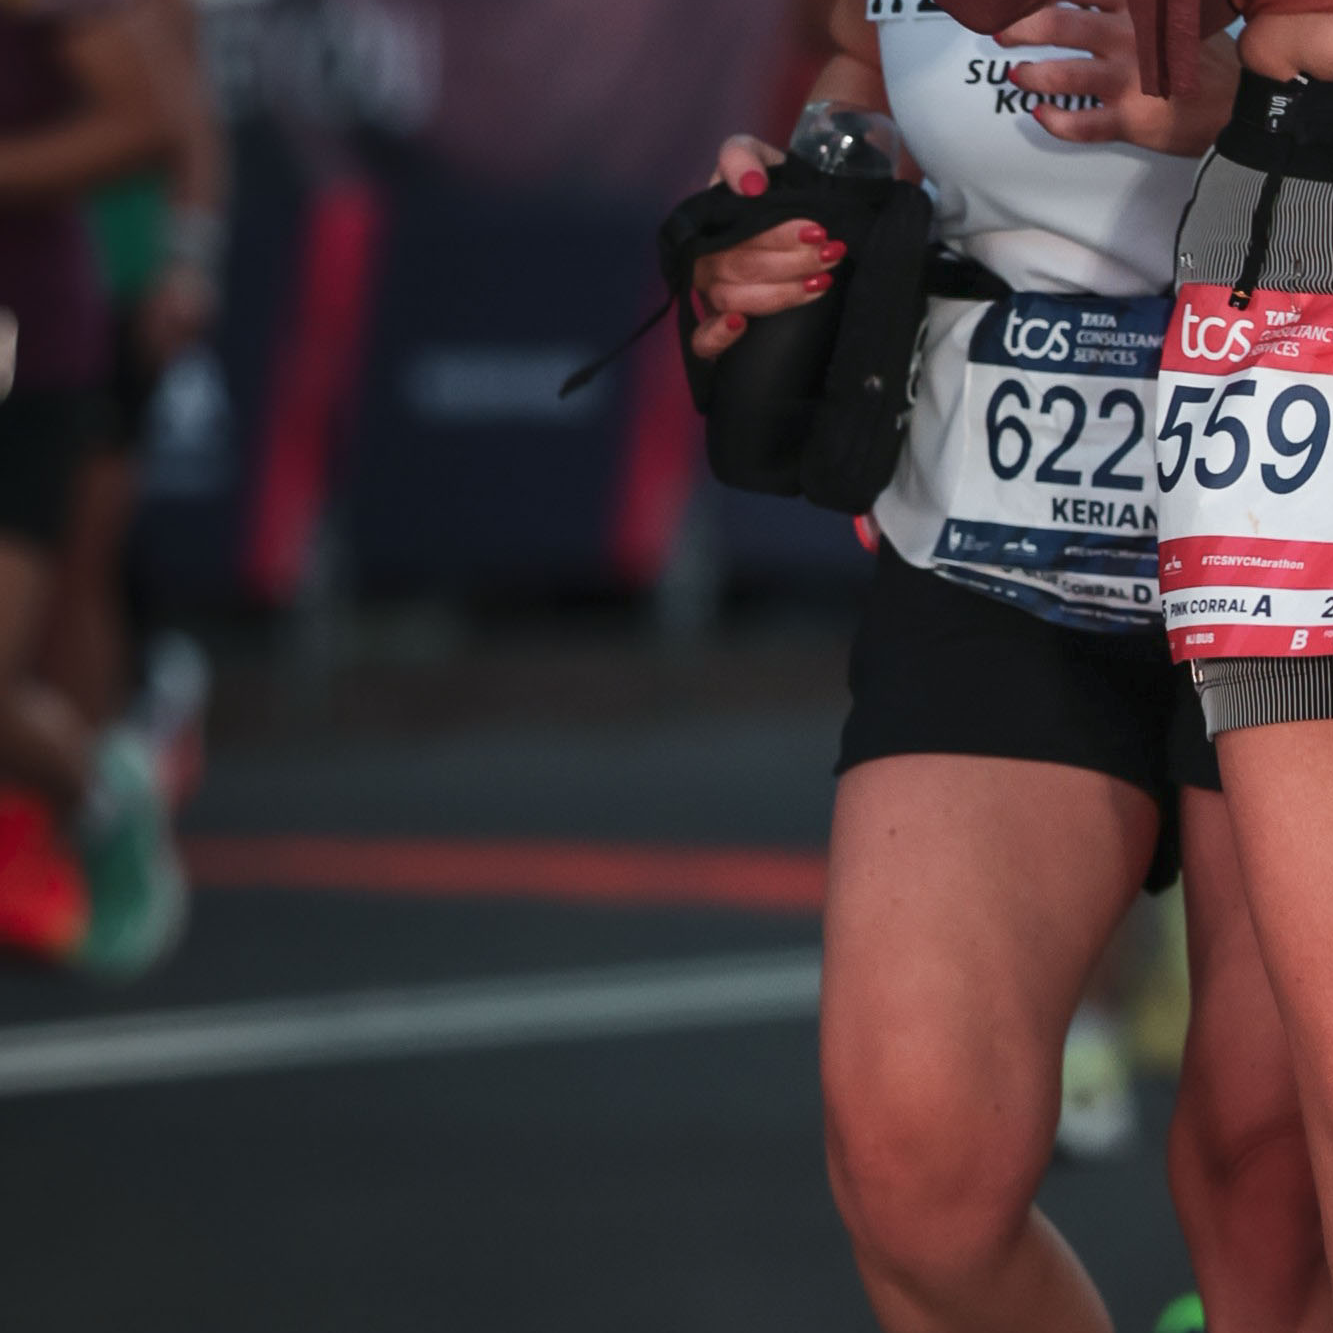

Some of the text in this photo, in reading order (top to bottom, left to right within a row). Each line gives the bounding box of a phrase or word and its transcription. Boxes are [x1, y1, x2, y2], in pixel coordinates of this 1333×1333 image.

[1080, 312, 1118, 328] TATA
[1002, 308, 1072, 361] tcs
[1181, 303, 1255, 363] tcs
[1073, 347, 1138, 366] SERVICES
[1201, 555, 1305, 570] #TCSNYCMarathon
[1133, 584, 1152, 605] D
[1190, 598, 1248, 614] CORRAL
[1251, 594, 1272, 617] A
[1290, 629, 1309, 651] B
